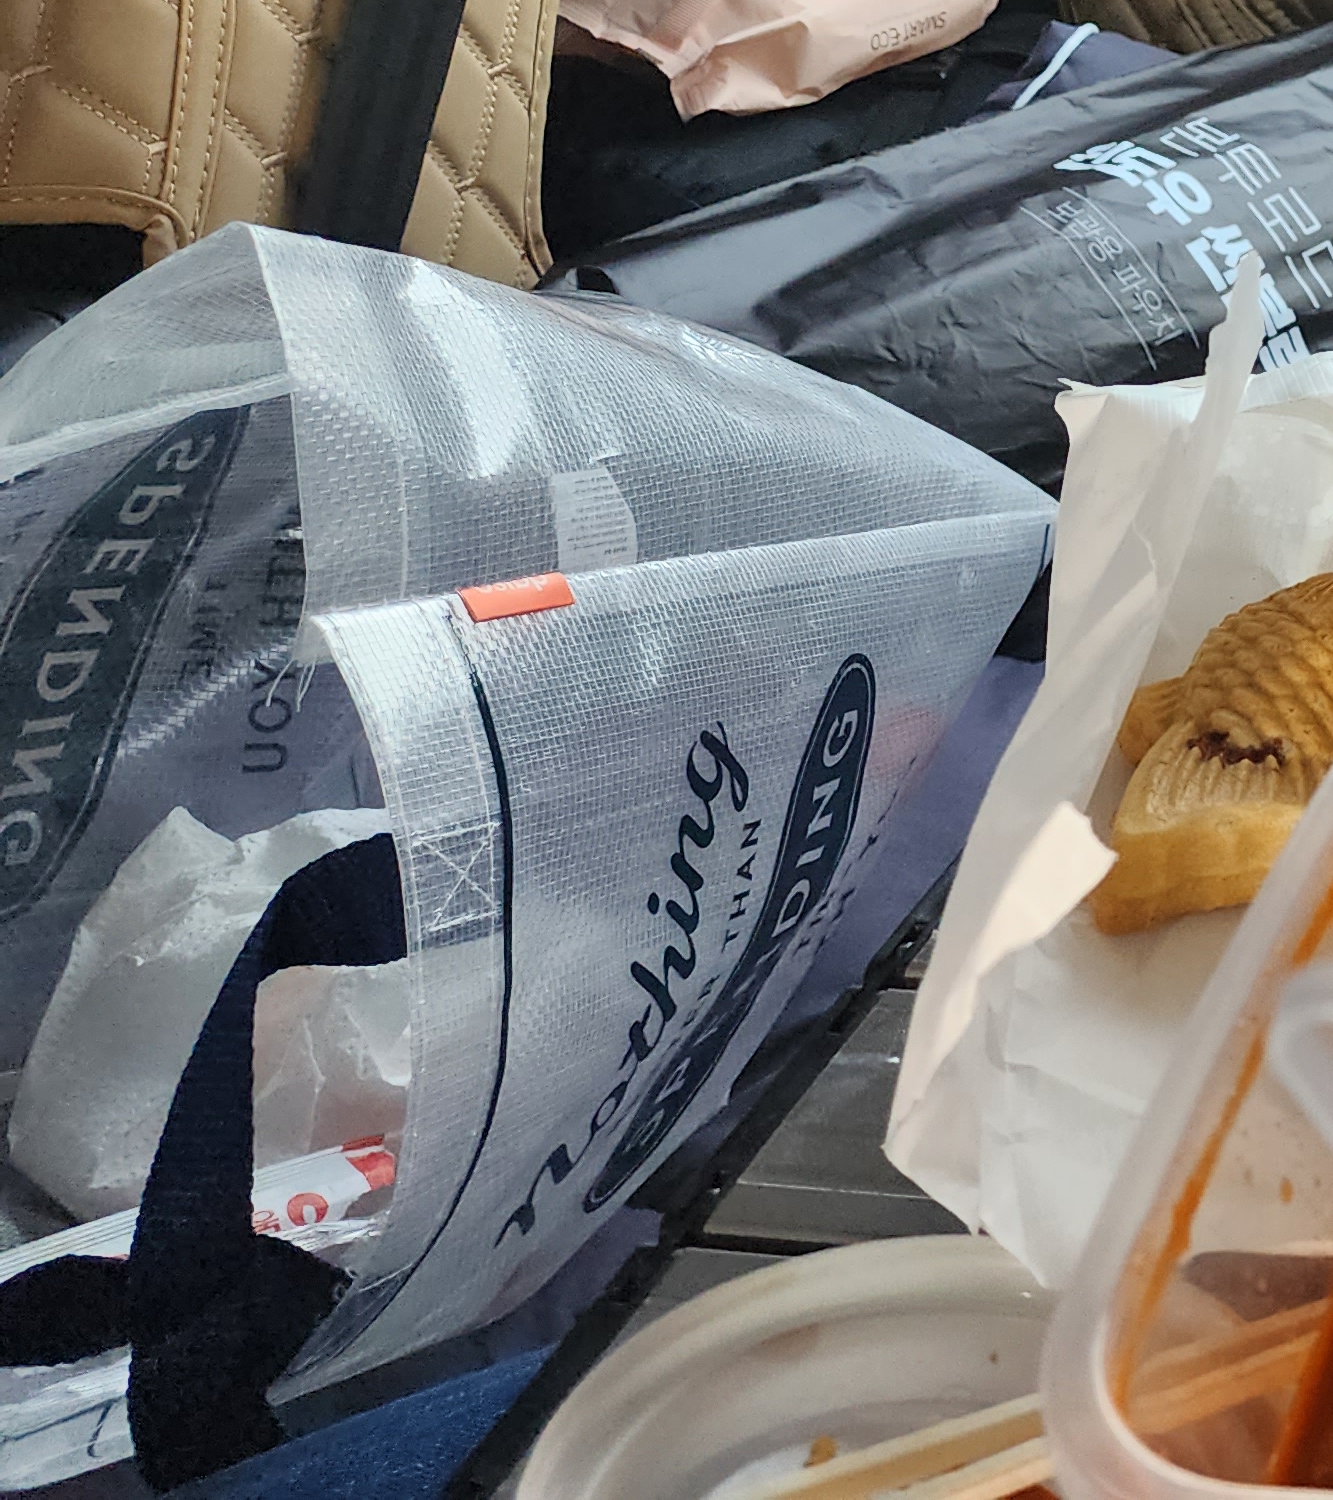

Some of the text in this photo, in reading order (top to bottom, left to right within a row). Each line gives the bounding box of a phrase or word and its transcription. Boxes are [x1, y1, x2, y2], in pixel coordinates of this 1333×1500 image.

[1046, 199, 1185, 347] 보관용 파우치
[722, 817, 762, 952] THAN
[494, 720, 749, 1248] nothing
